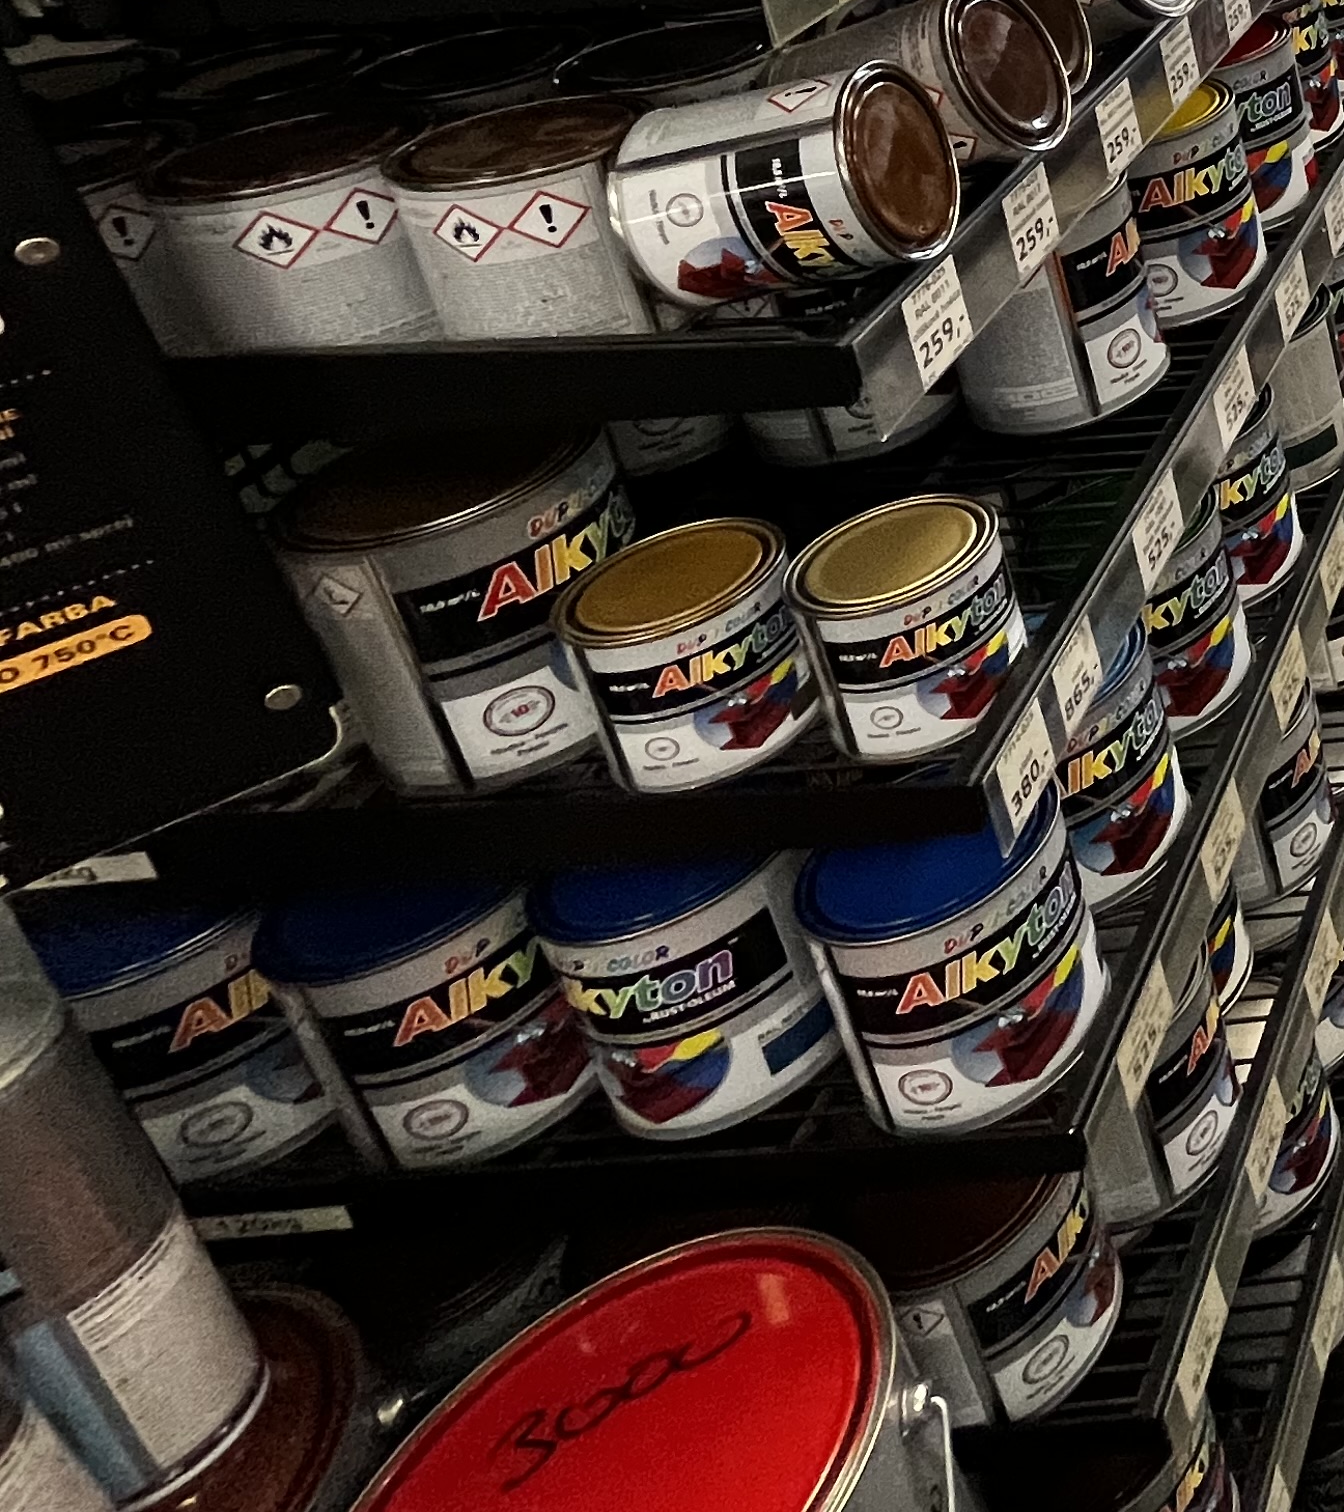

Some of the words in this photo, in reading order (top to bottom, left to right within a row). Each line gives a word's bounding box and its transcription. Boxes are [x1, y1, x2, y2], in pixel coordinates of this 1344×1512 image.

[1104, 122, 1141, 165] 259,-
[1014, 214, 1055, 260] 259,-
[918, 313, 966, 369] 259,-
[1063, 662, 1099, 722] 865,-
[1010, 750, 1050, 817] 380,-
